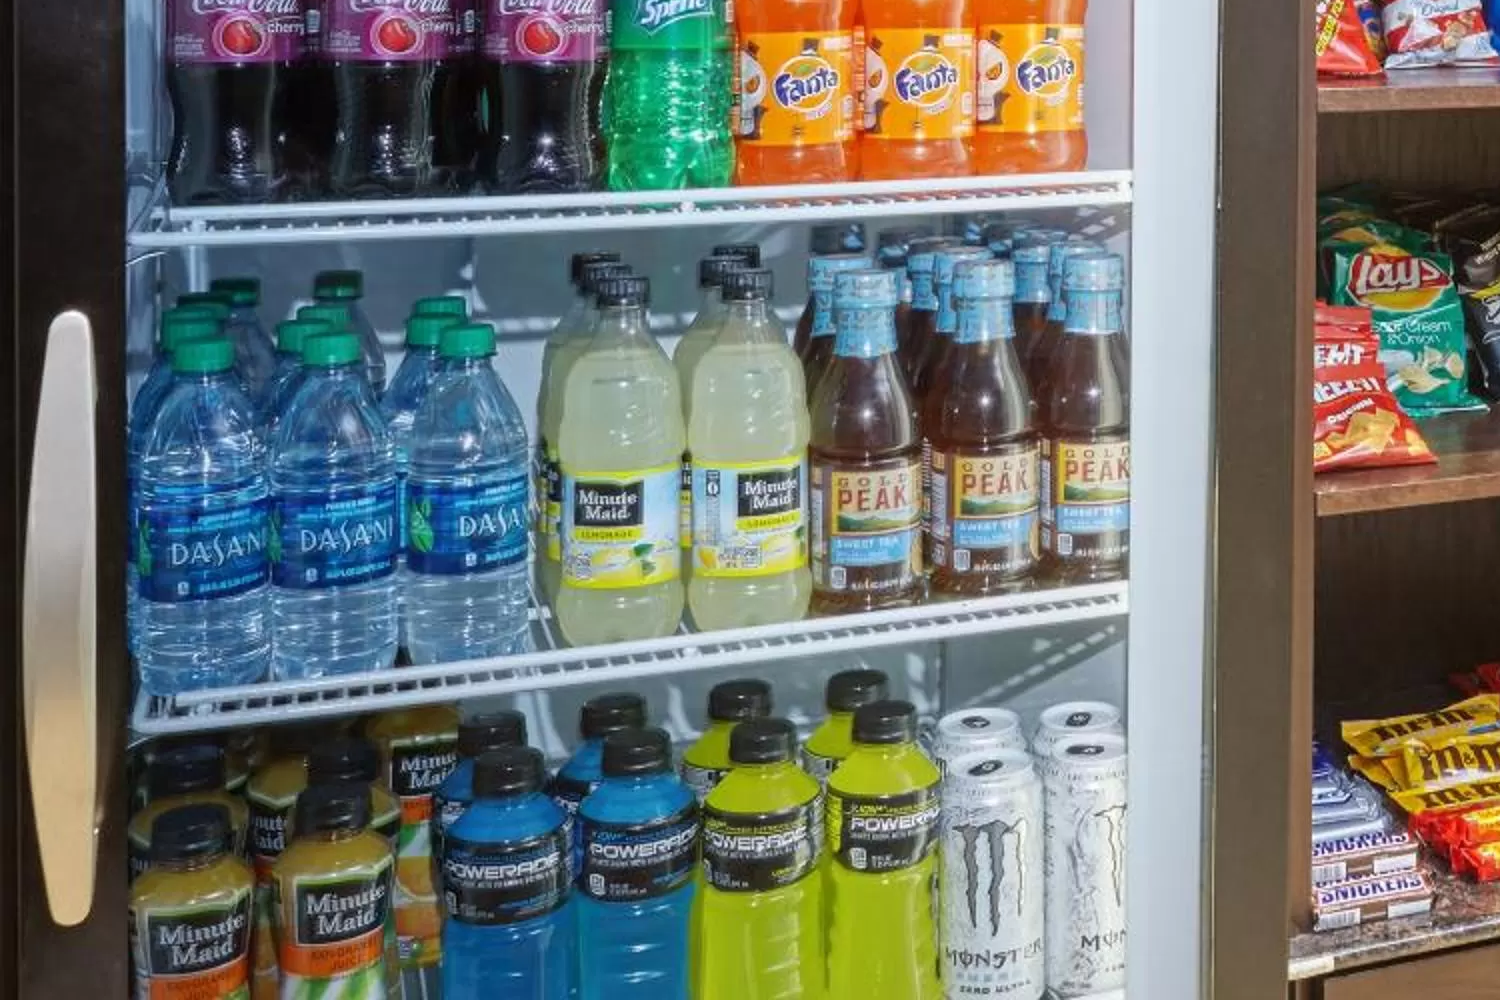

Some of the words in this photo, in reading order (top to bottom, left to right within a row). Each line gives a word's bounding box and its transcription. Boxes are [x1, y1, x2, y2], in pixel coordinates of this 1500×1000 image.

[773, 63, 839, 107] Fanta
[895, 63, 958, 106] Fanta
[1017, 58, 1077, 99] Fanta
[579, 489, 638, 506] Minute
[744, 477, 798, 496] Minute
[962, 470, 1030, 496] PEAK
[584, 504, 631, 520] Maid
[752, 493, 792, 510] Maid
[838, 486, 908, 512] PEAK
[300, 516, 393, 556] DASANI
[306, 883, 385, 915] Minute
[159, 911, 245, 946] Minute
[316, 906, 376, 936] Maid
[172, 939, 235, 967] Maid
